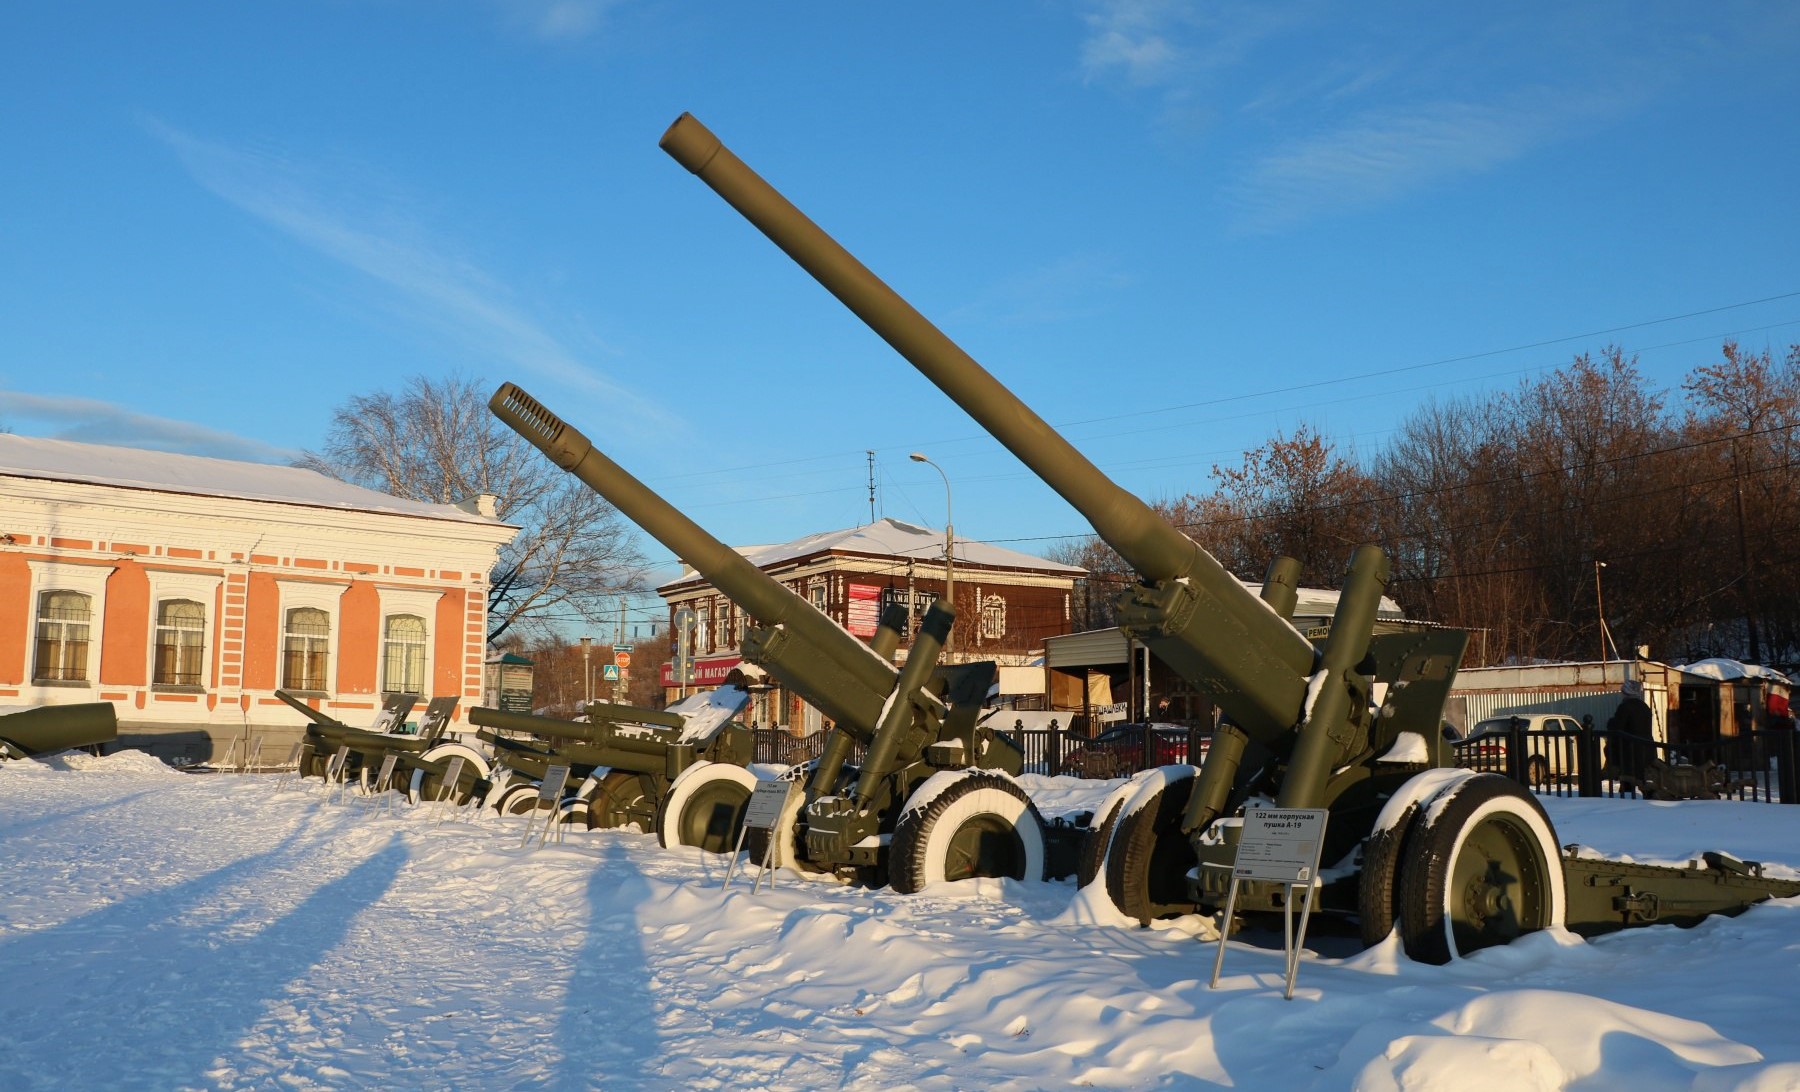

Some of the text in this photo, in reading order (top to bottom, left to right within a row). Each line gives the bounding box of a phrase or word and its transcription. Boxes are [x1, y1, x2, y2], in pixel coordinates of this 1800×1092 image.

[886, 594, 937, 604] ПАМЯНИКИ
[1308, 627, 1330, 637] РЕМО
[704, 666, 735, 679] МАГАЗИ
